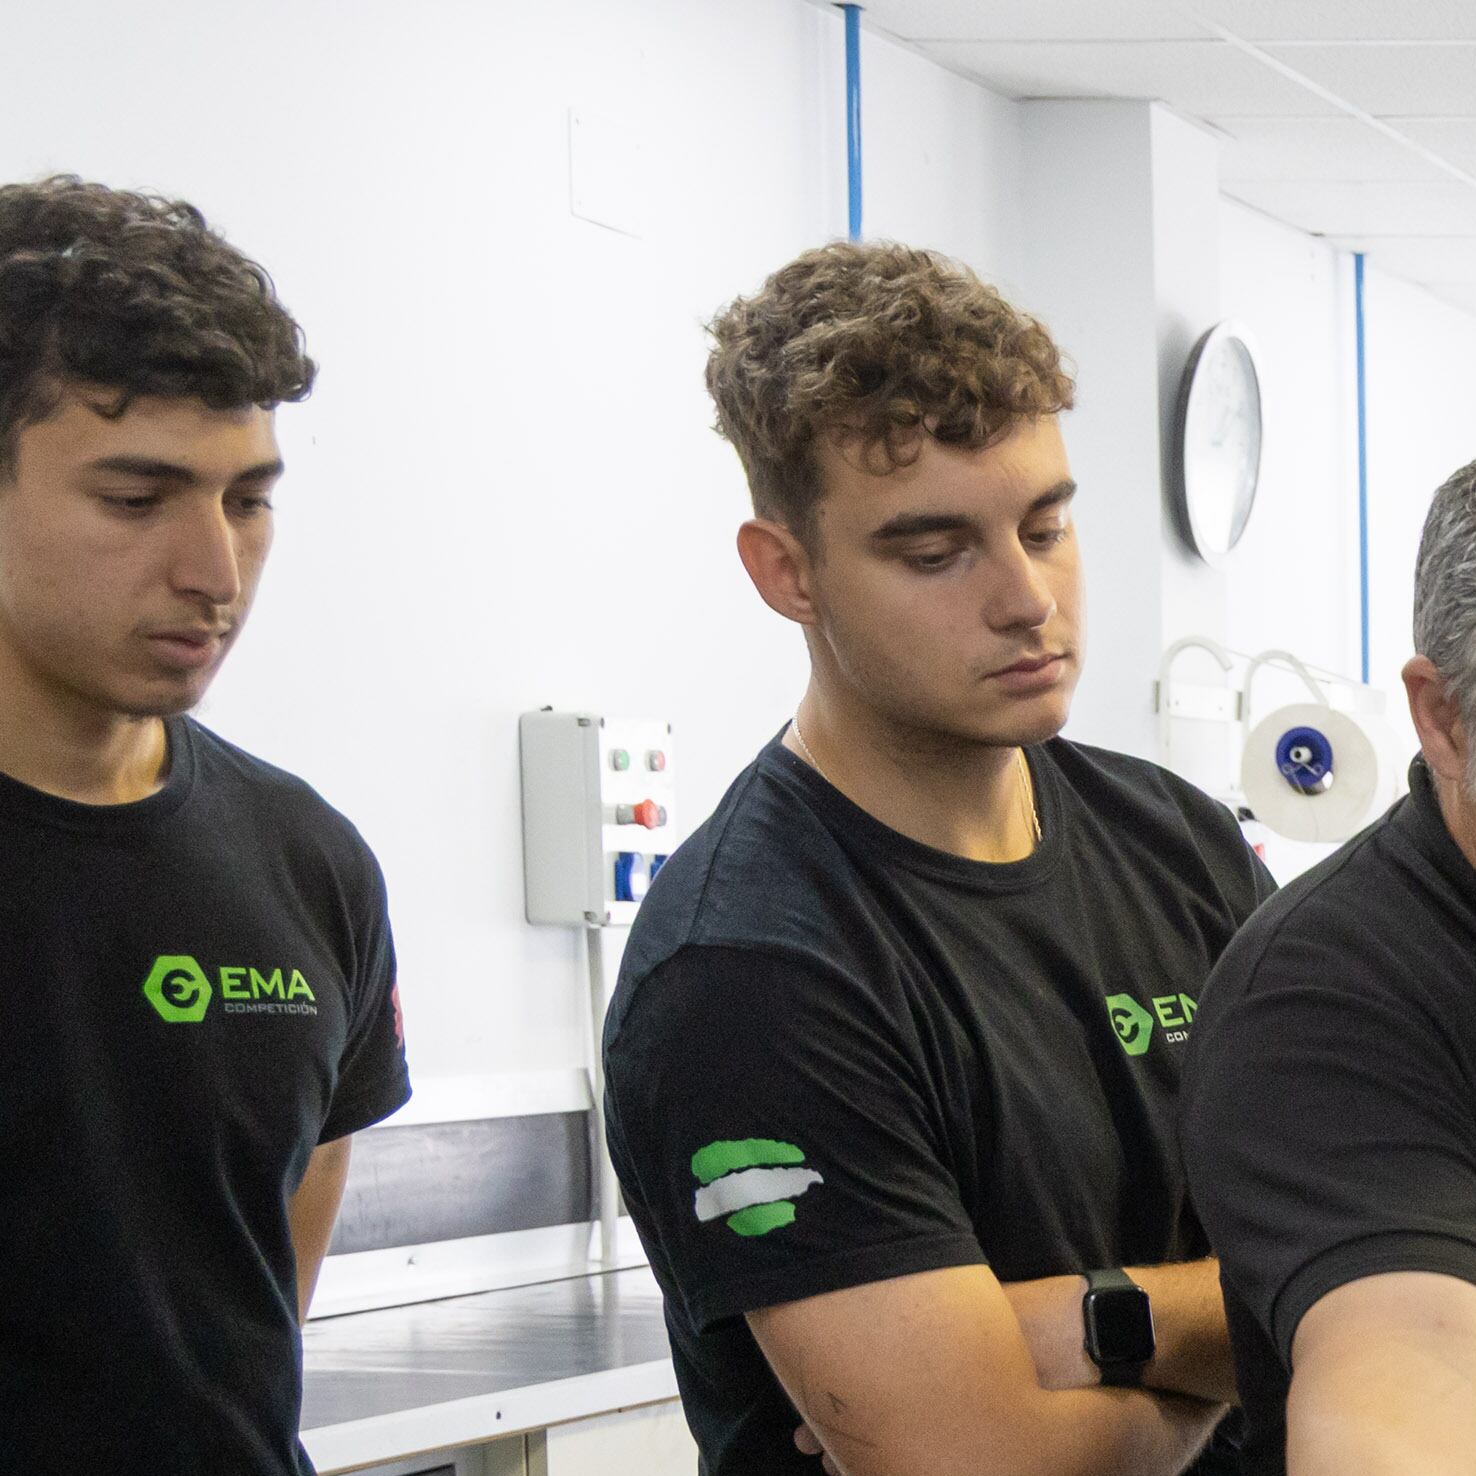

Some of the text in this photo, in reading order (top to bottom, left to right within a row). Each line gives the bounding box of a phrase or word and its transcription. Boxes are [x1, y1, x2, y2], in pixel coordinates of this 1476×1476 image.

[219, 966, 316, 1001] EMA
[224, 1001, 318, 1015] COMPETICIÓN
[1151, 993, 1199, 1029] EM
